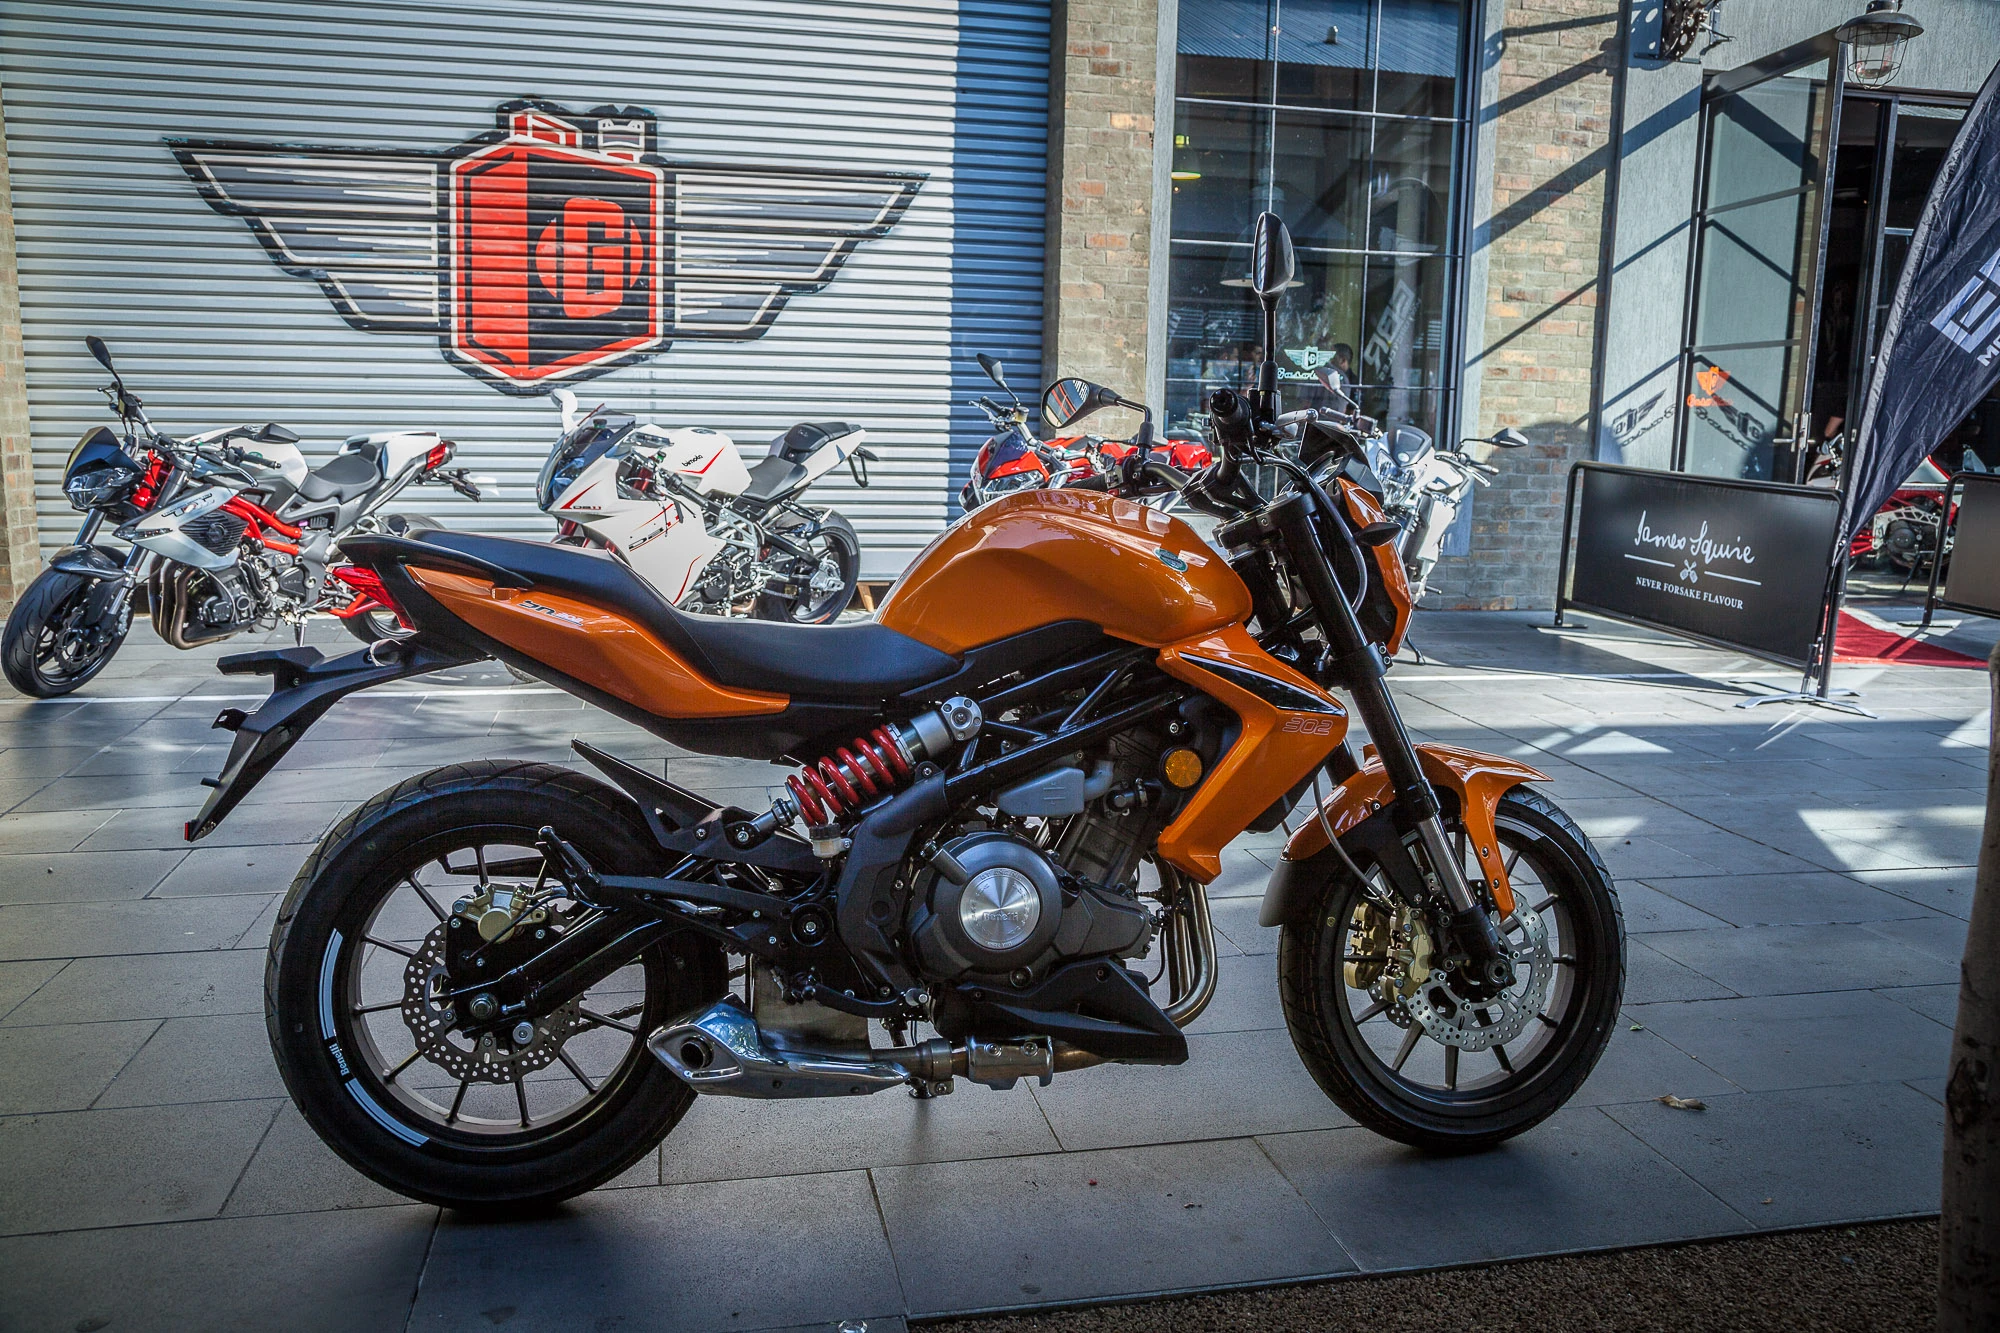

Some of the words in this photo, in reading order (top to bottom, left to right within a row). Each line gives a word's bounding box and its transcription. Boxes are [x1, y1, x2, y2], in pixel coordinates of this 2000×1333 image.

[563, 197, 625, 319] G
[1634, 510, 1686, 550] James
[1690, 520, 1755, 564] Squire
[1635, 576, 1662, 591] NEVER
[1663, 582, 1701, 600] FORSAKE
[1703, 591, 1744, 610] FLAVOUR
[1282, 716, 1334, 736] 302
[329, 1043, 350, 1076] Benelli
